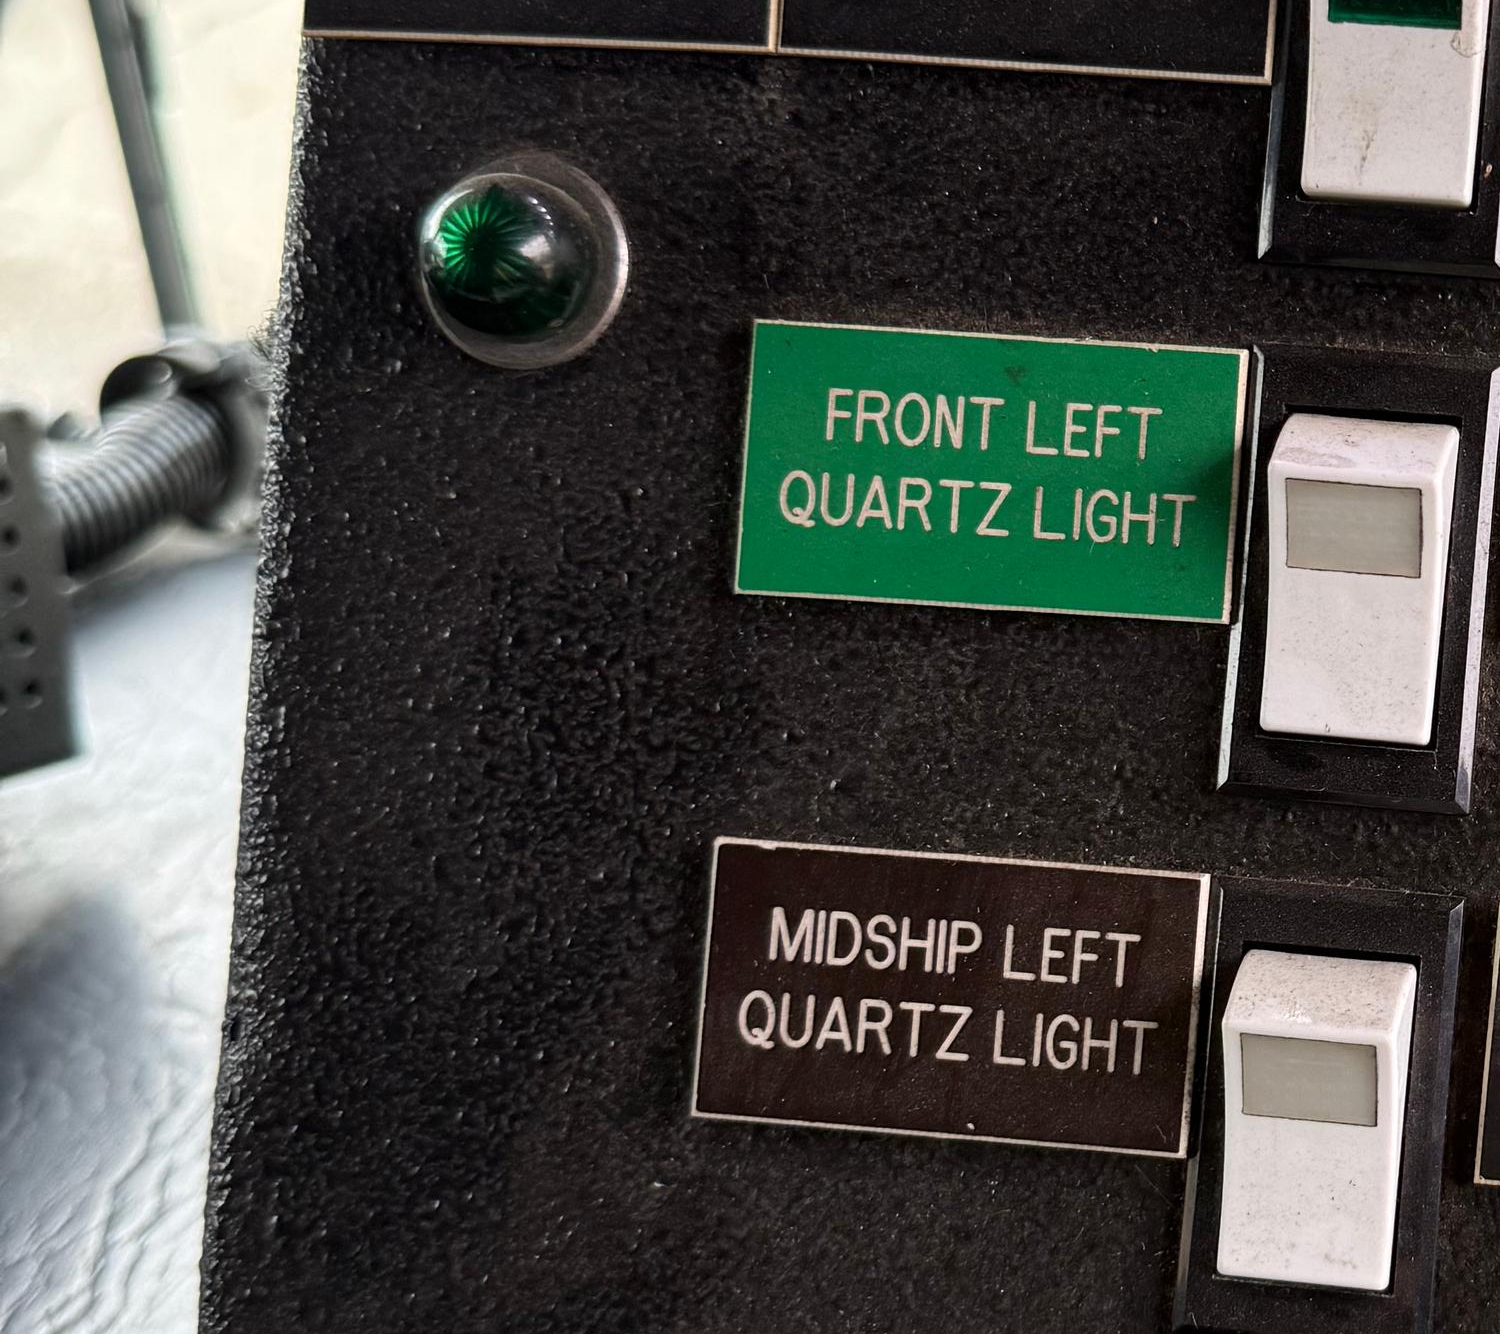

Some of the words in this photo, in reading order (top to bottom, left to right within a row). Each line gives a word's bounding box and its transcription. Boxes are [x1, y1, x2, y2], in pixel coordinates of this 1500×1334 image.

[825, 388, 1006, 450] FRONT
[1025, 400, 1163, 460] LEFT
[779, 469, 1012, 538] QUARTZ
[1032, 486, 1197, 547] LIGHT
[768, 906, 983, 974] MIDSHIP
[1002, 924, 1142, 988] LEFT
[737, 989, 973, 1061] QUARTZ
[992, 1009, 1159, 1076] LIGHT
